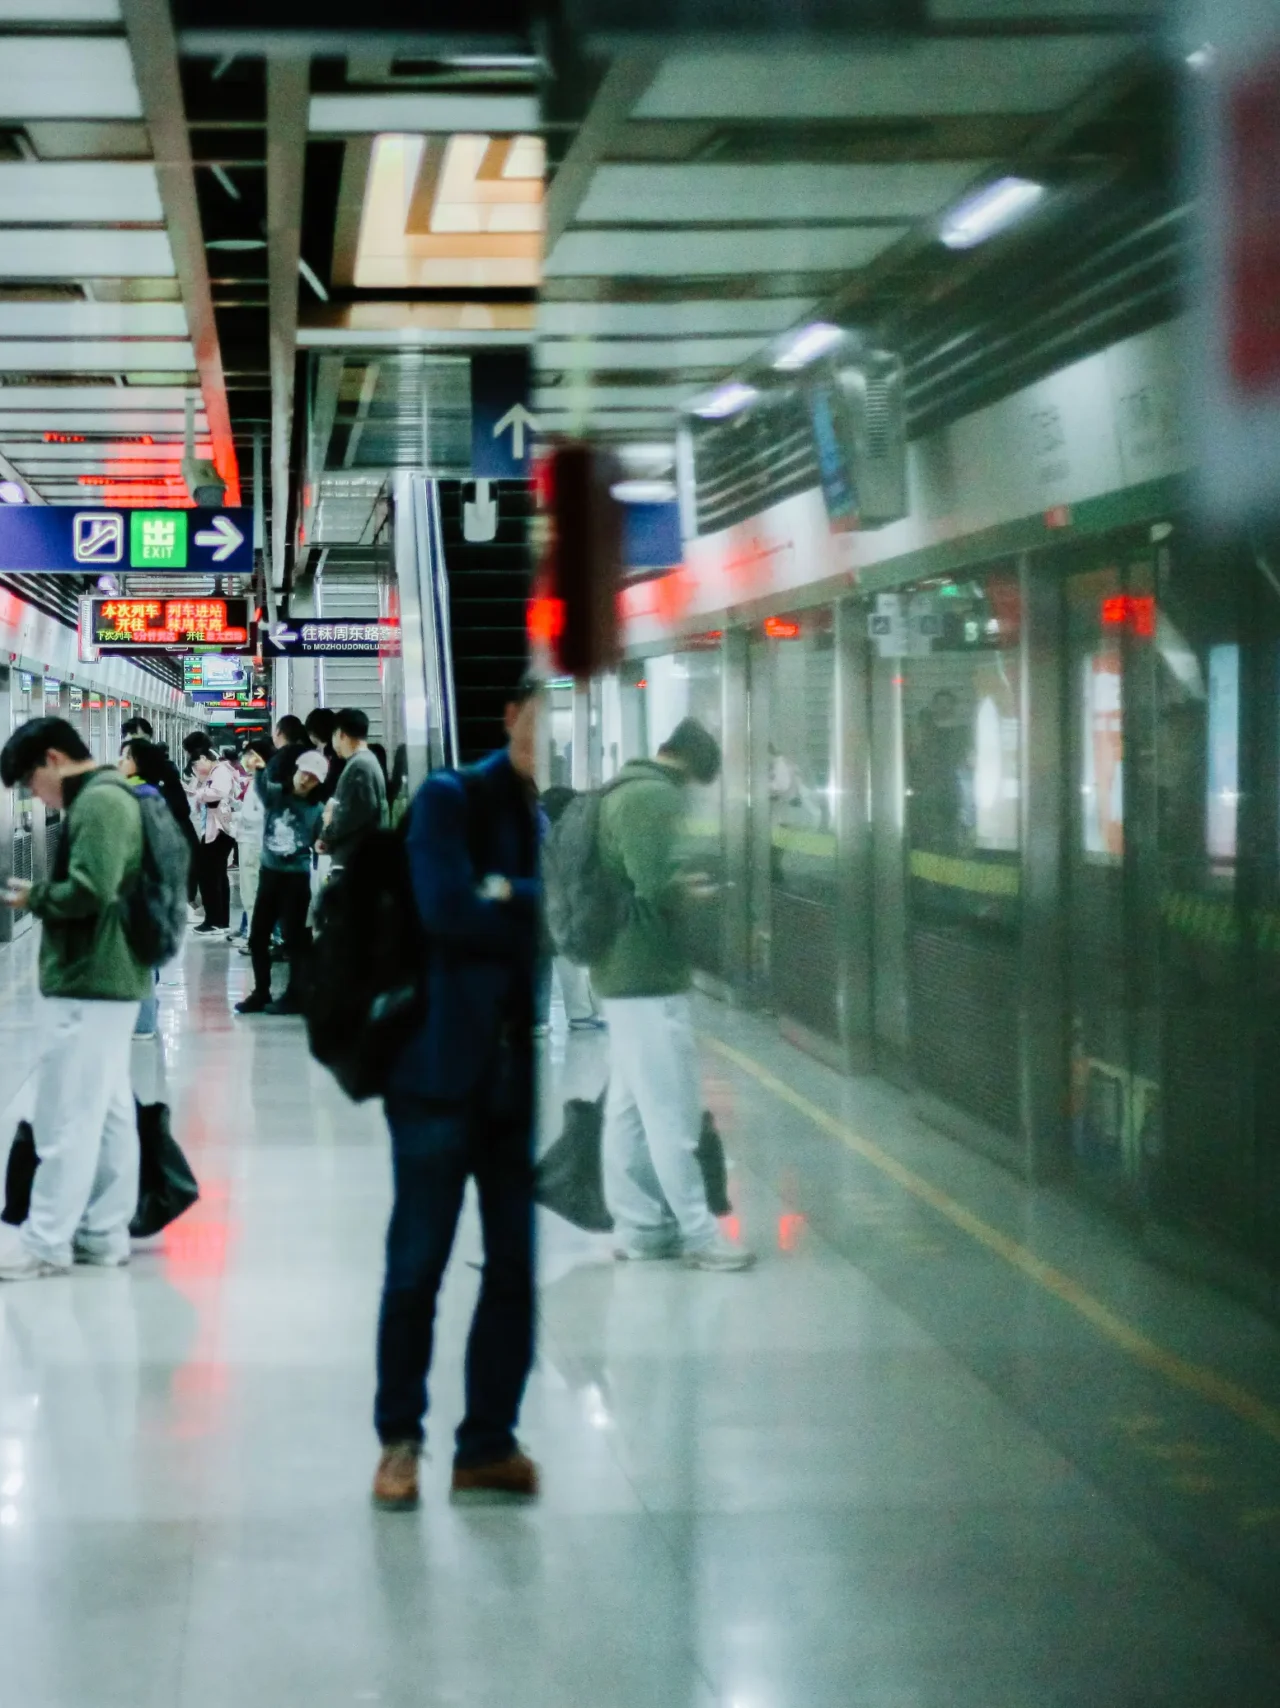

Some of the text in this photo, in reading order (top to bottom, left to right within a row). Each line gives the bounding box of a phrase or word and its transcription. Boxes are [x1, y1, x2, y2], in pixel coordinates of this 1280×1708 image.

[143, 519, 175, 545] 出
[142, 546, 174, 559] EXIT
[103, 603, 222, 618] 本次列车 列车进站
[115, 618, 146, 632] 开往
[96, 631, 132, 641] 下次列车
[186, 631, 205, 641] 开往
[302, 625, 379, 641] 往秣周东路
[313, 643, 380, 651] MOZHOUDONGLU
